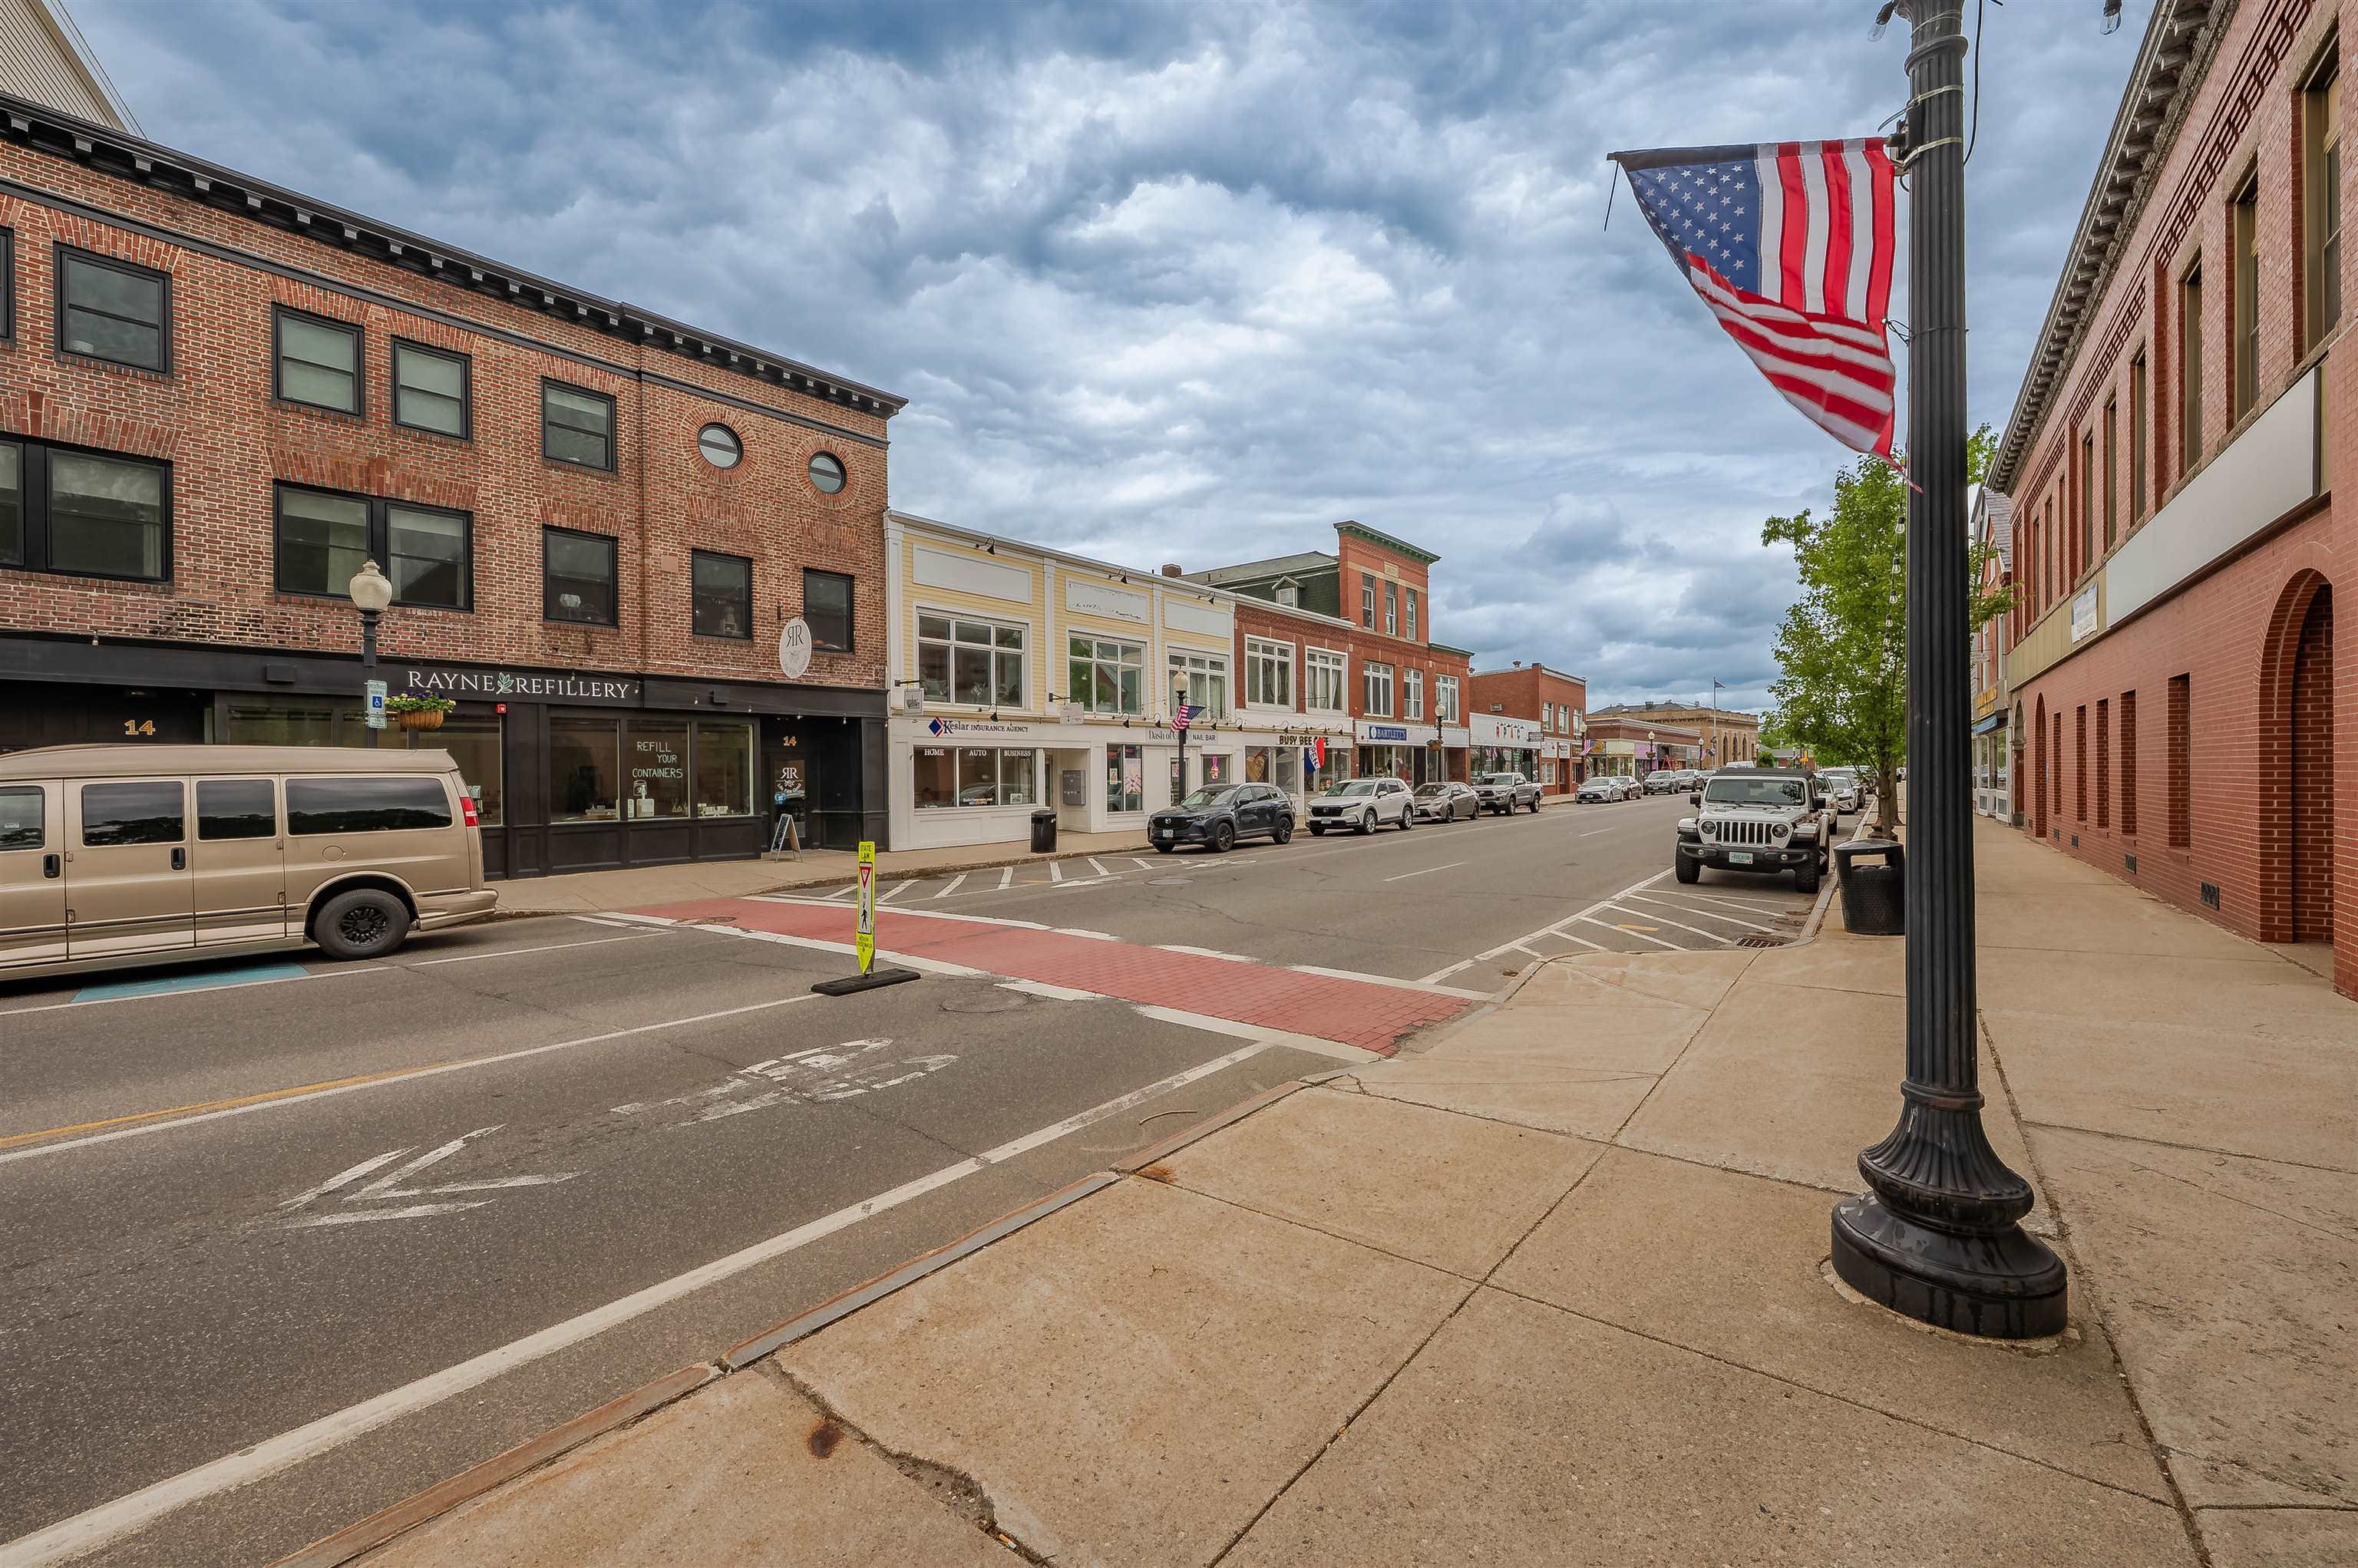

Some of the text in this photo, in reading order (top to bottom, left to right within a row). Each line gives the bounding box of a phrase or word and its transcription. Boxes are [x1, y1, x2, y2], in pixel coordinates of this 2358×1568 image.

[408, 671, 629, 698] RAYNE REFILLERY
[124, 720, 156, 734] 14
[943, 721, 969, 734] Keslar
[783, 736, 797, 746] 14
[1280, 735, 1297, 744] BUSY
[1299, 736, 1312, 745] BEE
[637, 741, 672, 752] REFILL
[657, 754, 678, 763] YOUR
[632, 767, 683, 778] CONTAINERS
